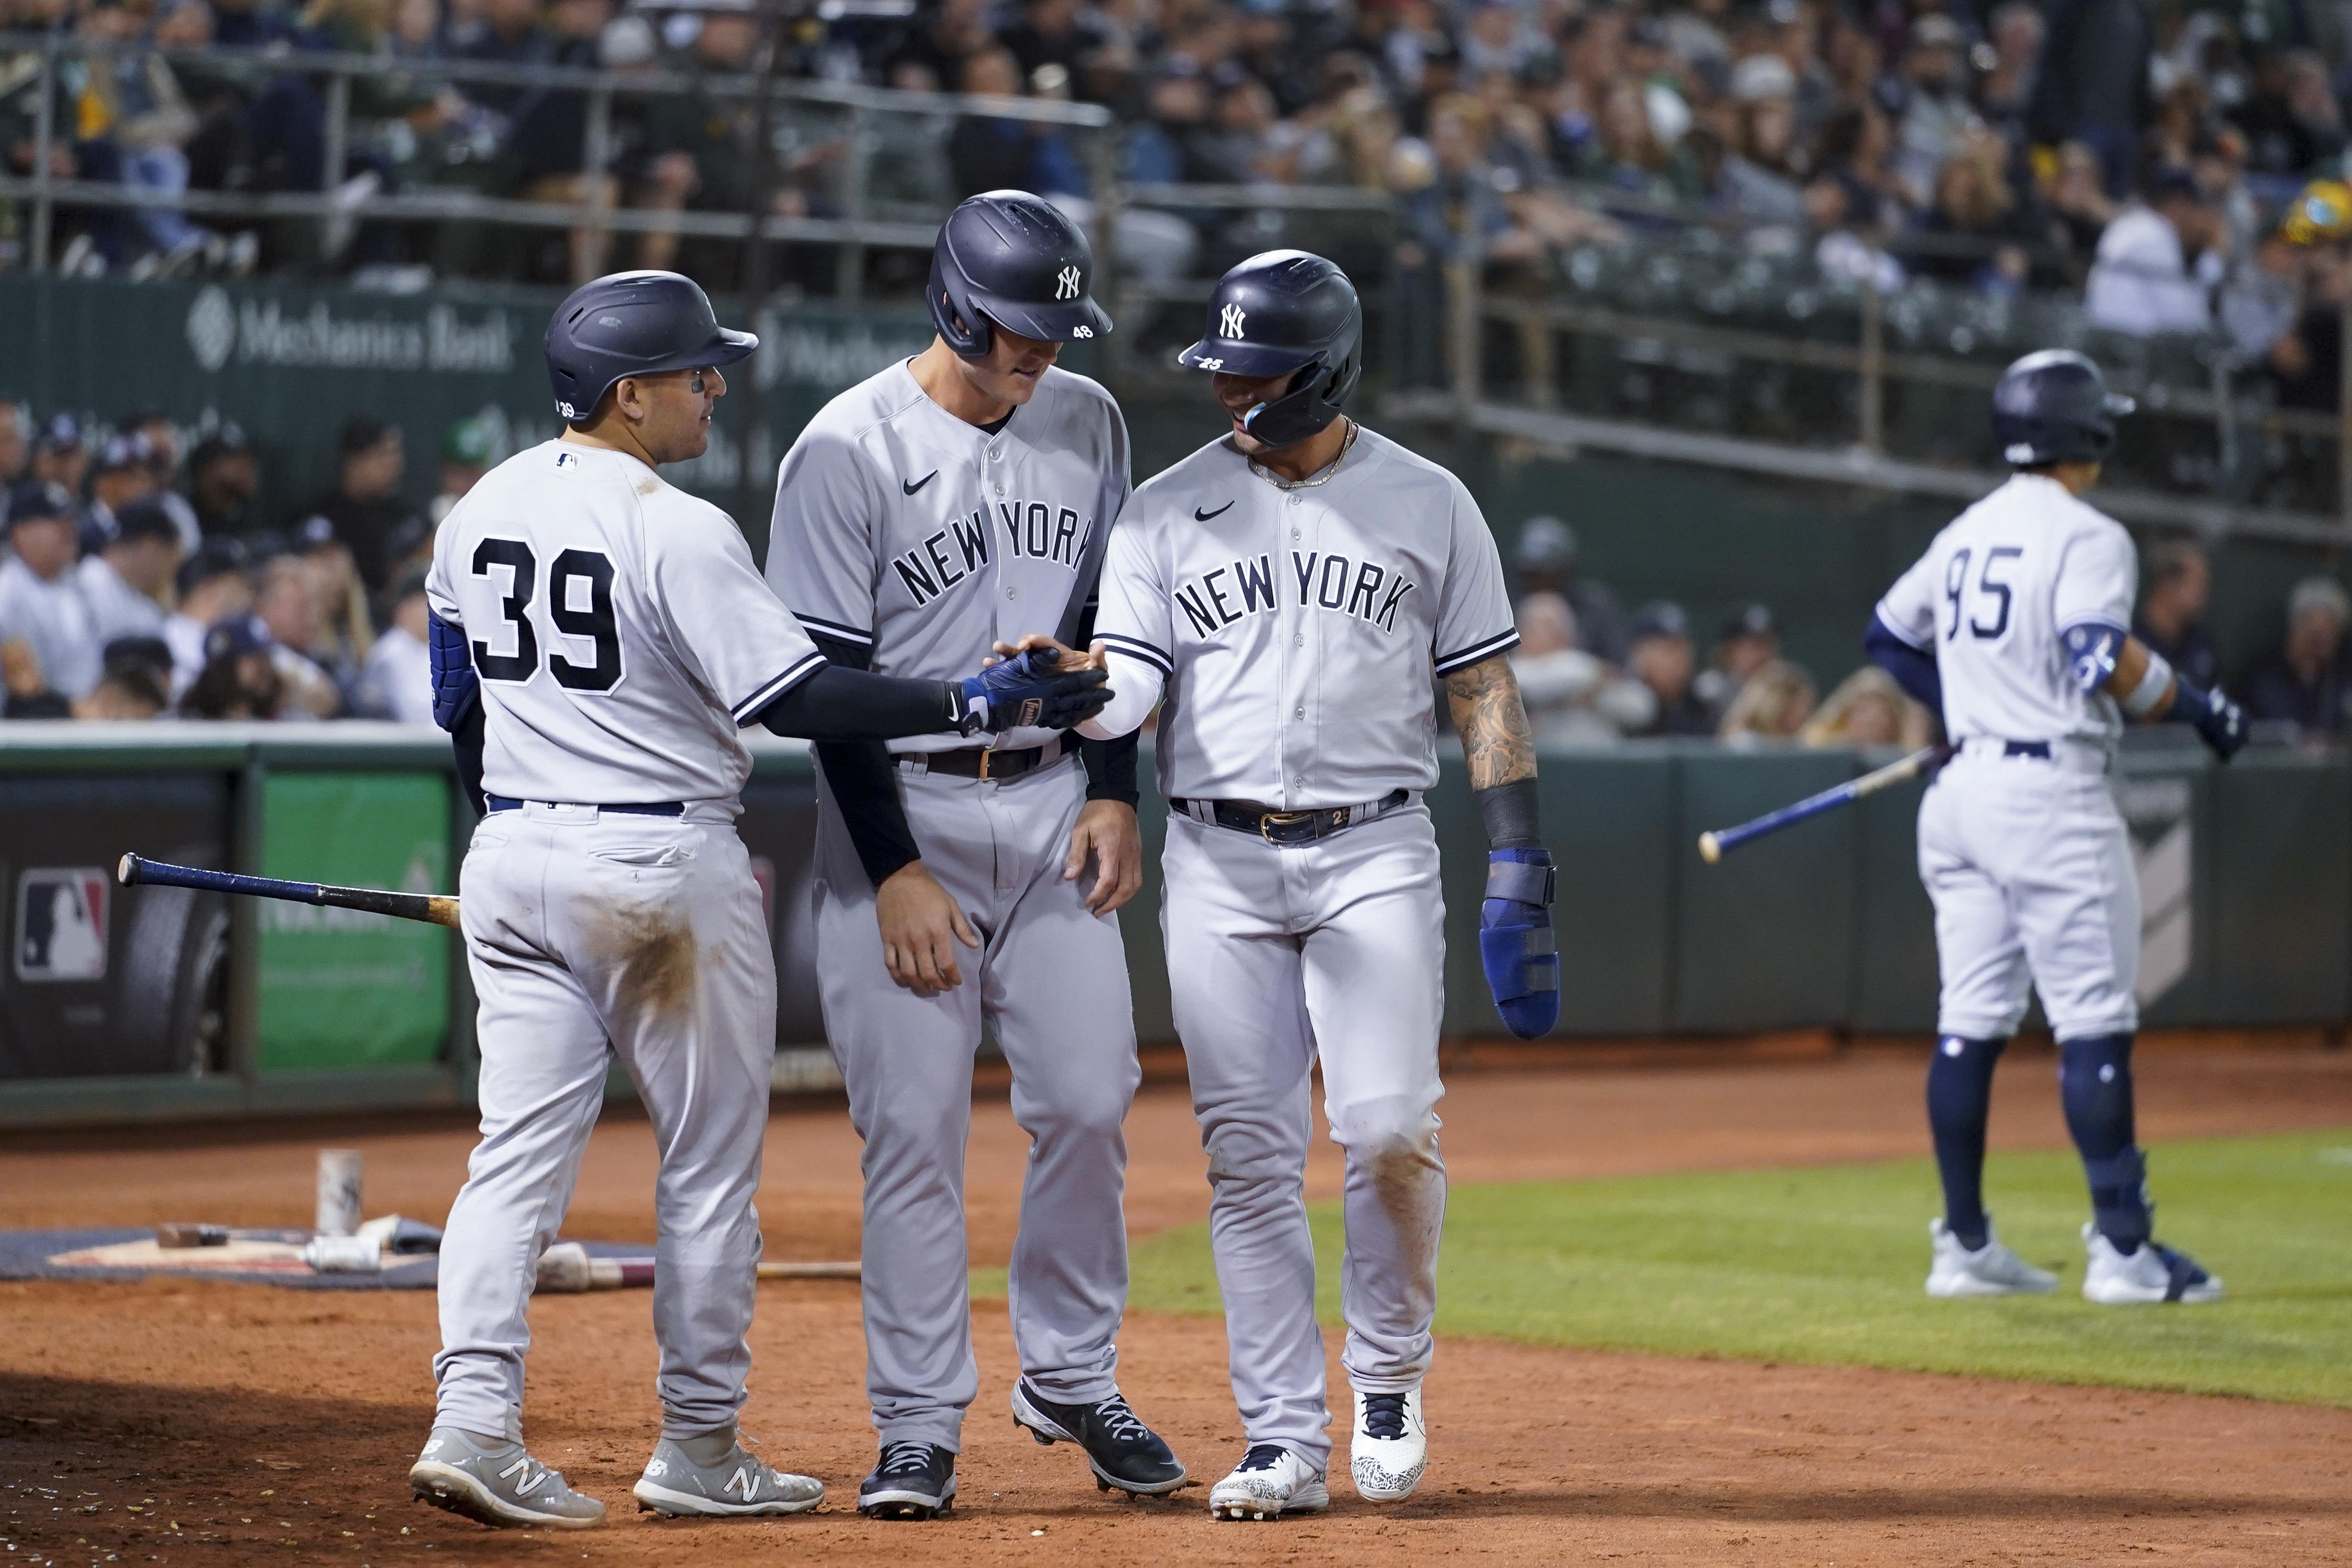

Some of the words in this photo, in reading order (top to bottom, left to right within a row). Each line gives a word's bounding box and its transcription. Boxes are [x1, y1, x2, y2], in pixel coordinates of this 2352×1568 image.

[1055, 265, 1081, 300] NY
[1073, 325, 1093, 338] 48
[1219, 303, 1246, 340] NY
[1199, 357, 1223, 370] 25
[560, 401, 574, 418] 39
[890, 509, 990, 608] NEW
[1172, 552, 1277, 642] NEW
[1290, 549, 1417, 635] YORK
[1946, 547, 2023, 641] 95
[469, 533, 627, 696] 39
